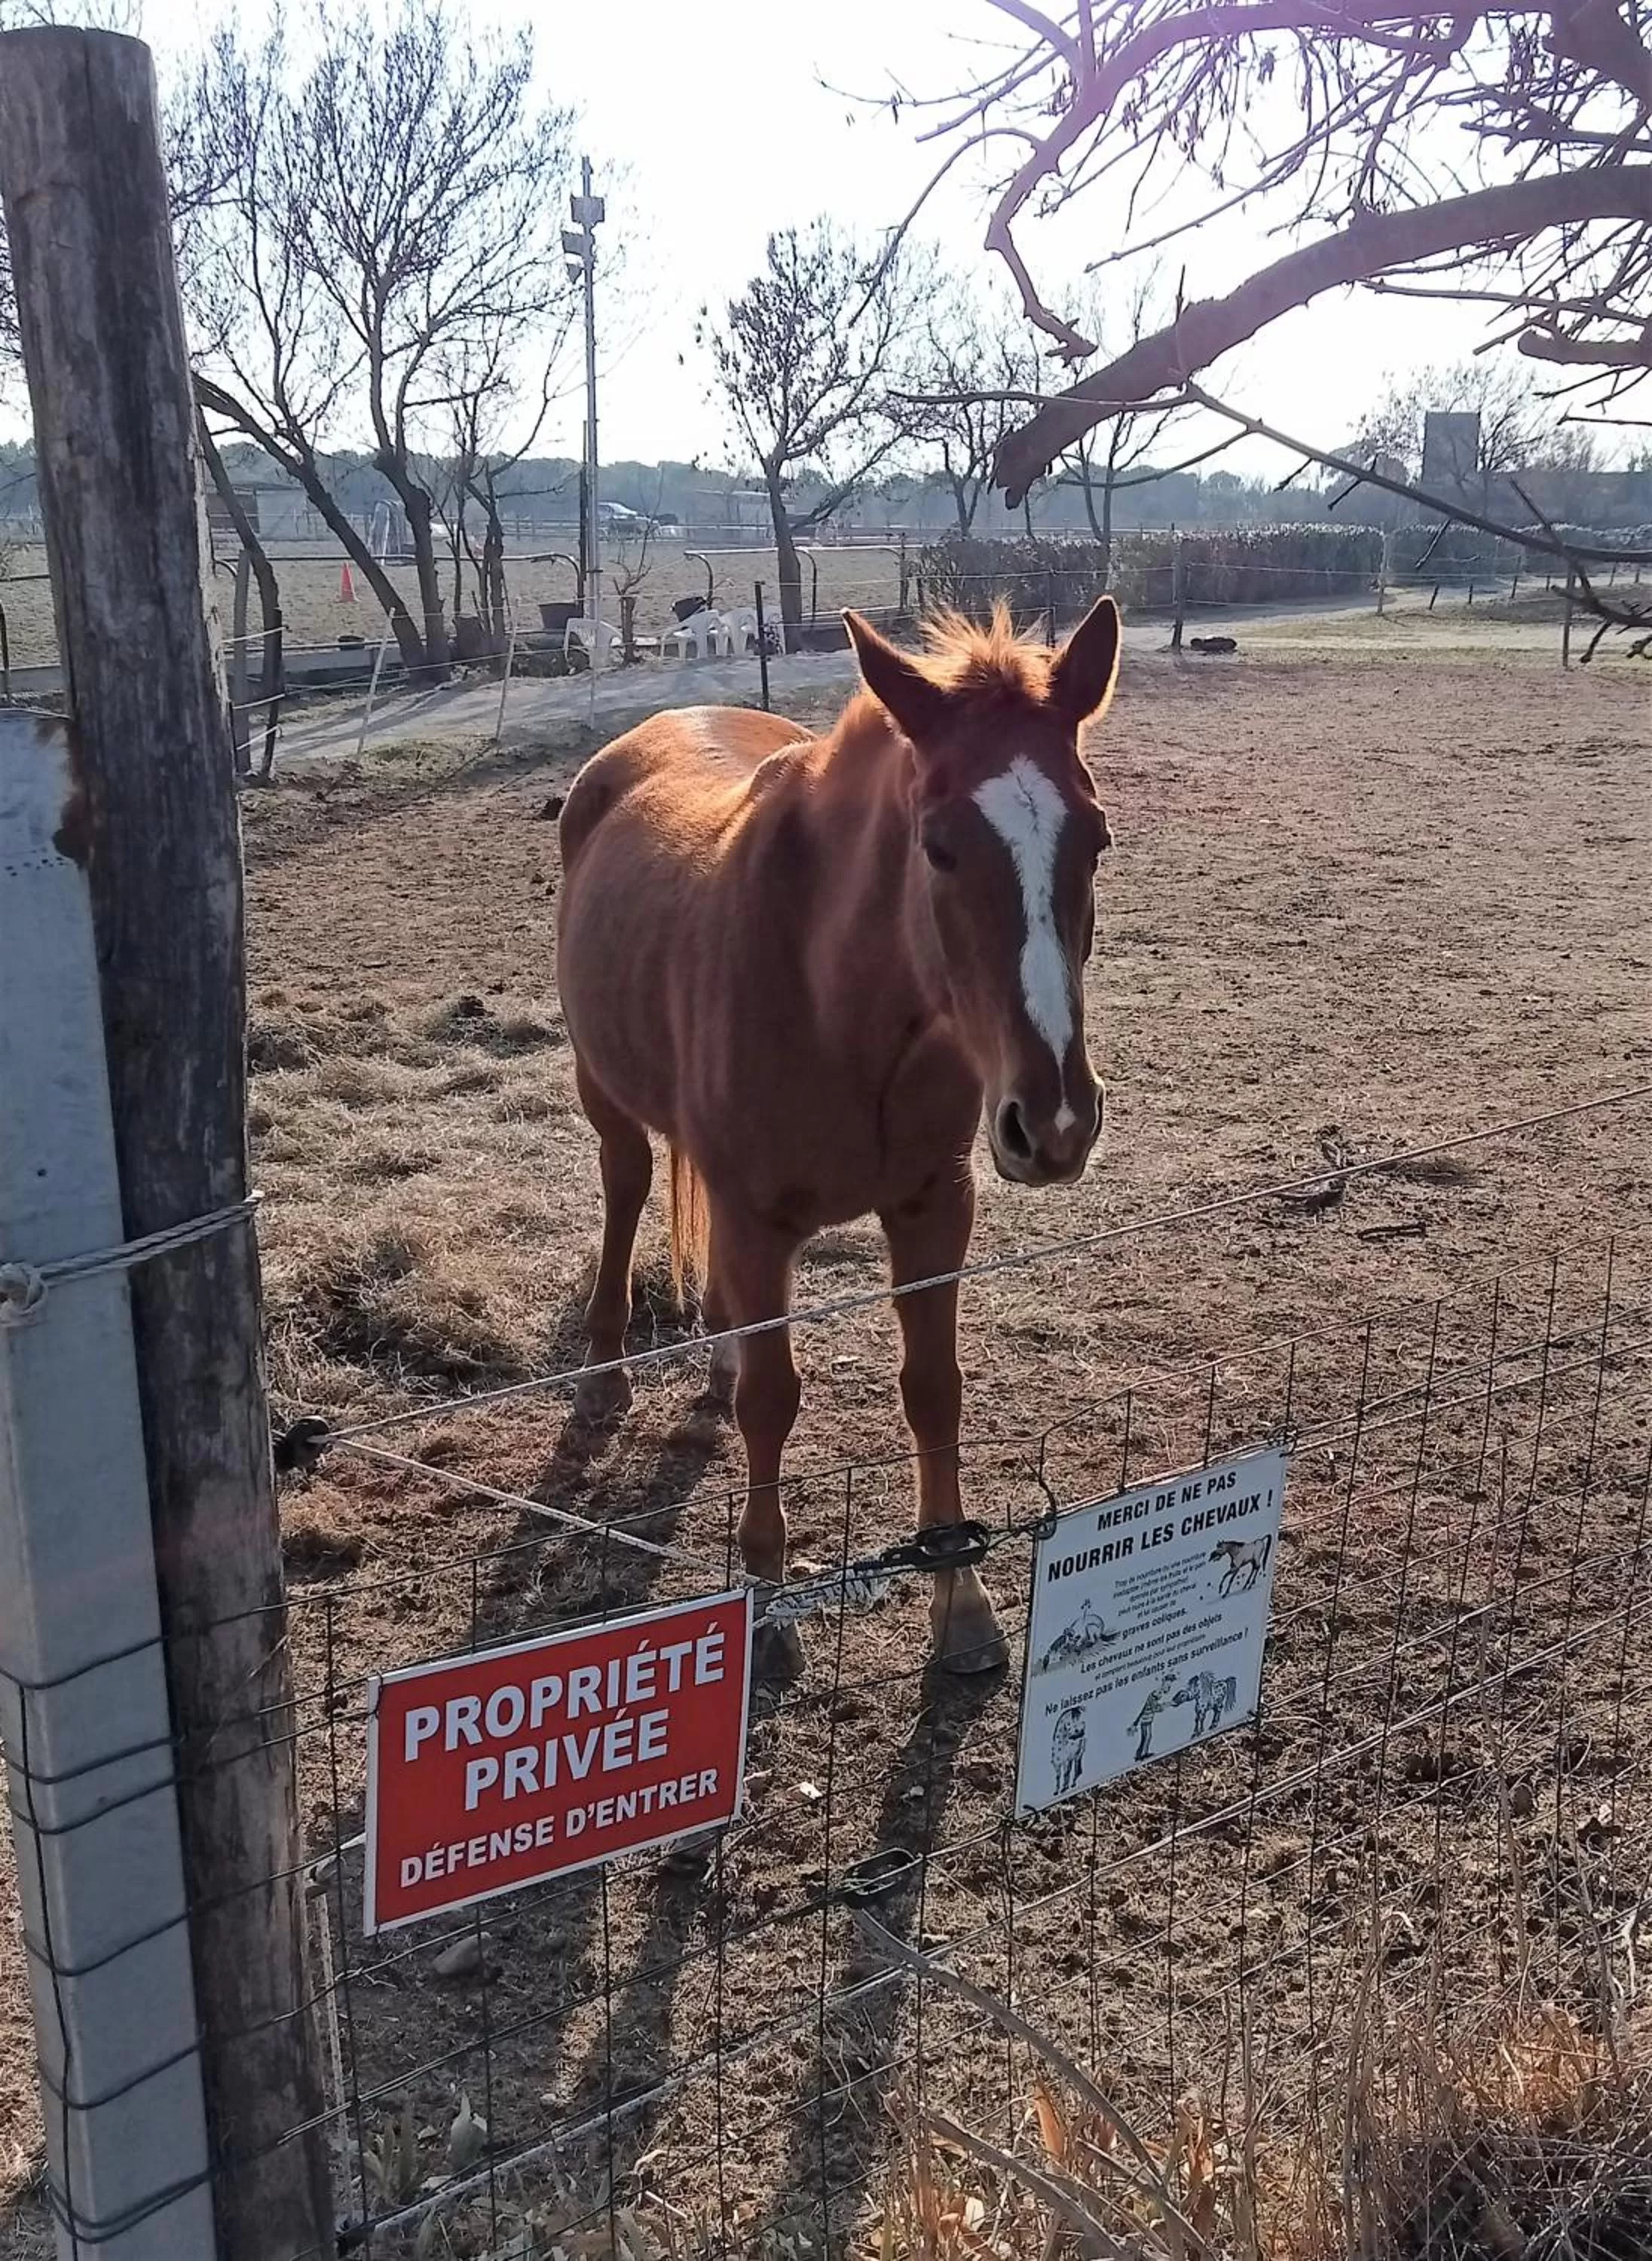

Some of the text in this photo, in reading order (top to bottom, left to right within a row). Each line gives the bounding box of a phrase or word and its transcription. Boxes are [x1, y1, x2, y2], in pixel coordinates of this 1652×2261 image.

[1048, 1536, 1134, 1583] NOURRIR
[1140, 1522, 1174, 1550] LES
[1181, 1493, 1262, 1537] CHEVAUX
[1097, 1471, 1237, 1531] MERCI DE NE PAS
[1081, 1662, 1097, 1673] Les
[1099, 1648, 1132, 1666] chevaux
[1134, 1643, 1145, 1654] ne
[1146, 1634, 1164, 1649] sont
[1166, 1629, 1181, 1642] pas
[1182, 1623, 1197, 1635] des
[1198, 1614, 1222, 1629] objets
[1122, 1621, 1150, 1640] graves
[404, 1621, 726, 1762] PROPRIÉTÉ
[1045, 1703, 1059, 1717] Ne
[1060, 1690, 1094, 1709] laissez
[1096, 1681, 1113, 1698] pas
[1115, 1675, 1129, 1688] les
[1131, 1662, 1165, 1681] enfants
[1167, 1653, 1189, 1668] sans
[1191, 1632, 1243, 1659] surveillance
[464, 1708, 669, 1811] PRIVÉE
[400, 1768, 718, 1888] DÉFENSE D'ENTRER
